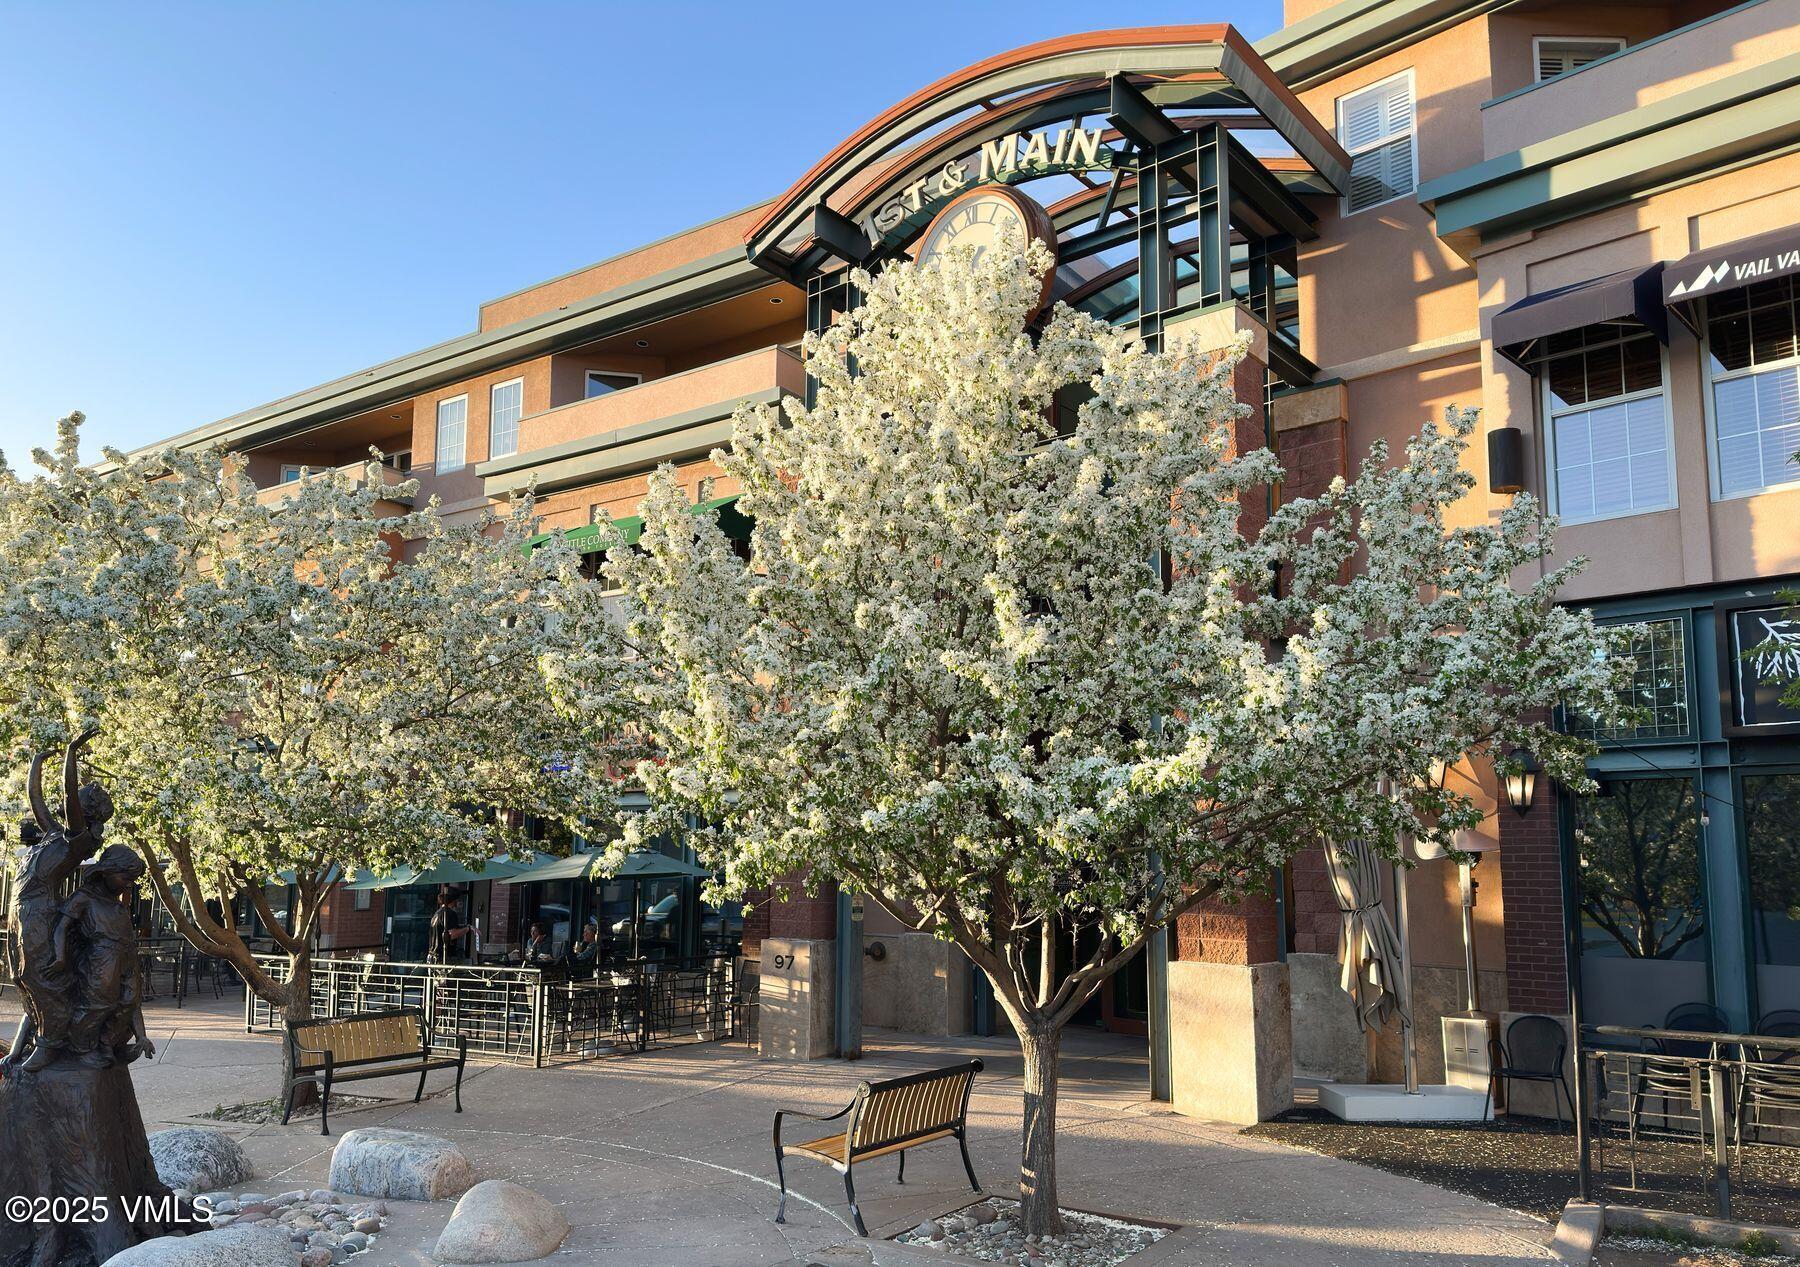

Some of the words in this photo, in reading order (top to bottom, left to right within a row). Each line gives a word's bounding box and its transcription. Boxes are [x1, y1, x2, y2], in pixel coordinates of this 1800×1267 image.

[859, 174, 930, 249] 1ST
[939, 160, 970, 195] &
[979, 129, 1104, 182] MAIN
[1734, 258, 1773, 280] VAIL
[1777, 250, 1800, 270] VA
[565, 537, 586, 548] ITLE
[587, 529, 629, 546] CONY
[774, 955, 795, 970] 97
